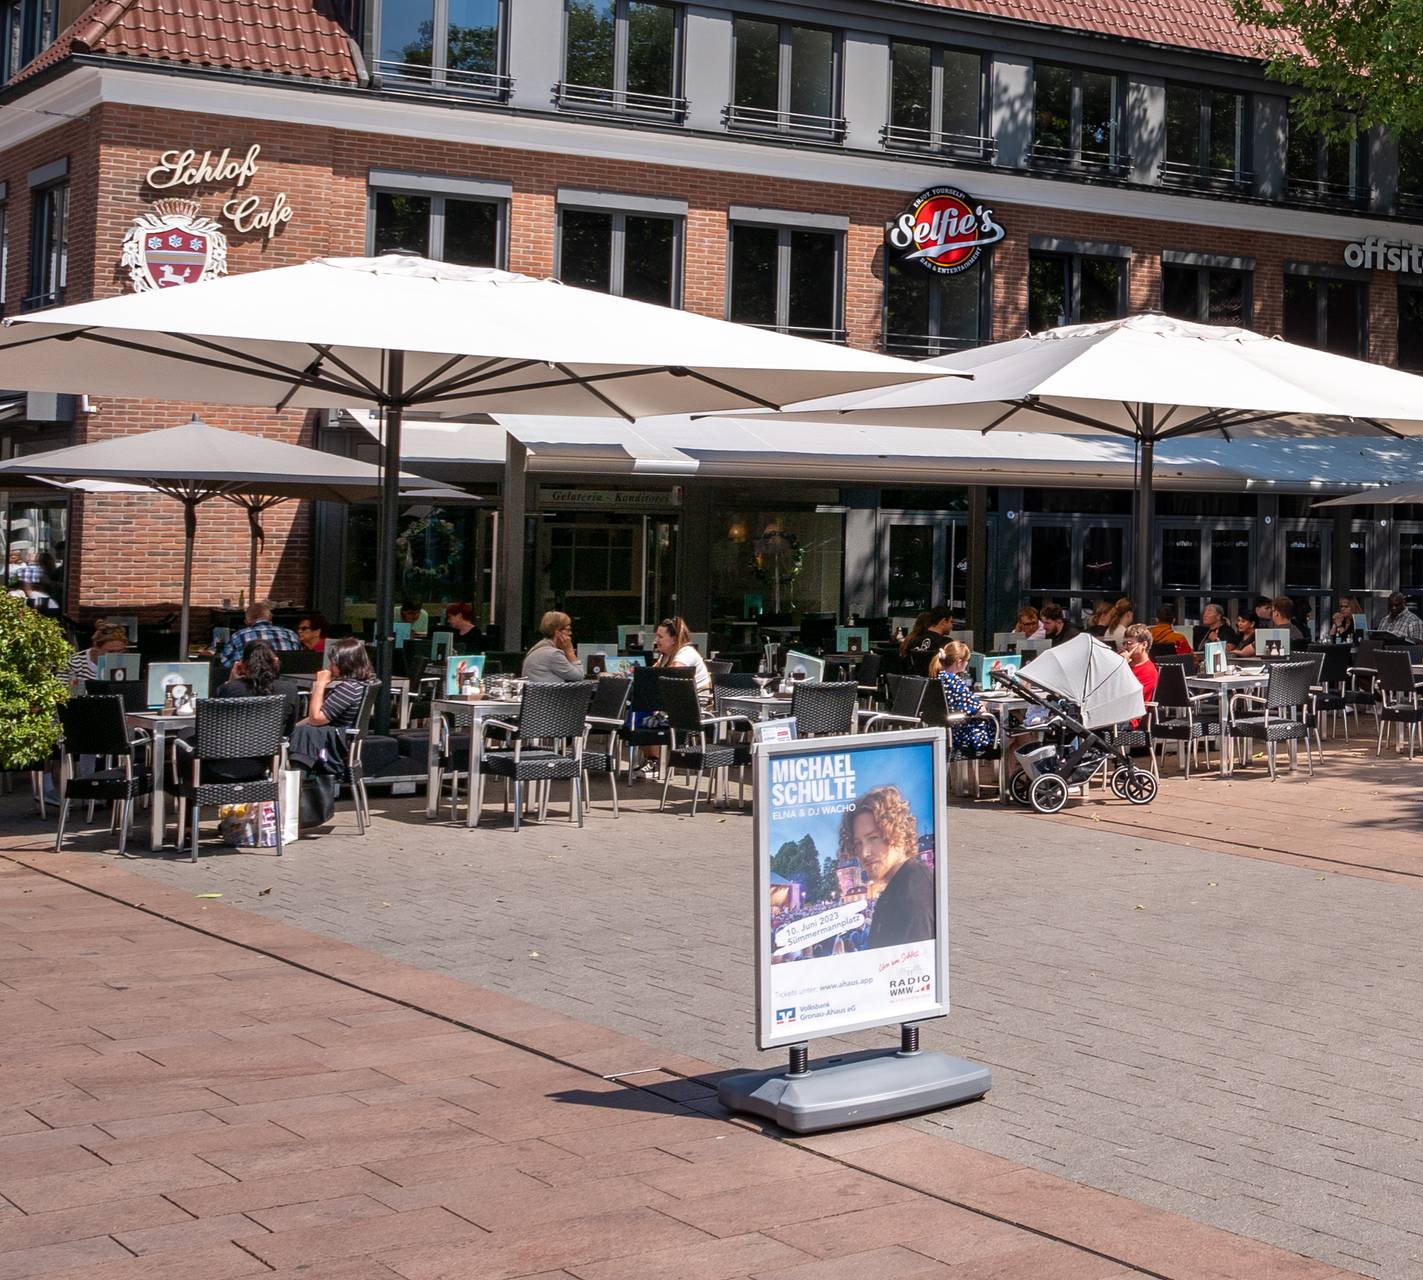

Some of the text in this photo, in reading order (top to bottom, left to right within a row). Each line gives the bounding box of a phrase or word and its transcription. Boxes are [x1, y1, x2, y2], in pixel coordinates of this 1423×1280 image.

[146, 143, 261, 189] Schloß
[223, 192, 293, 238] Cafe
[890, 205, 994, 247] Selfie's
[919, 256, 932, 269] BAR
[937, 247, 982, 274] ENTERTAINMENT
[772, 754, 856, 783] MICHAEL
[772, 776, 857, 806] SCHULTE
[773, 803, 857, 820] ELNA & DJ WACHO
[786, 911, 840, 937] 10. Juni 2023
[819, 977, 874, 991] www.ahaus.app
[890, 975, 931, 988] RADIO
[890, 986, 913, 997] WMW
[799, 1001, 830, 1012] Volksbank
[800, 1003, 857, 1021] Gronau-Ahaus eG
